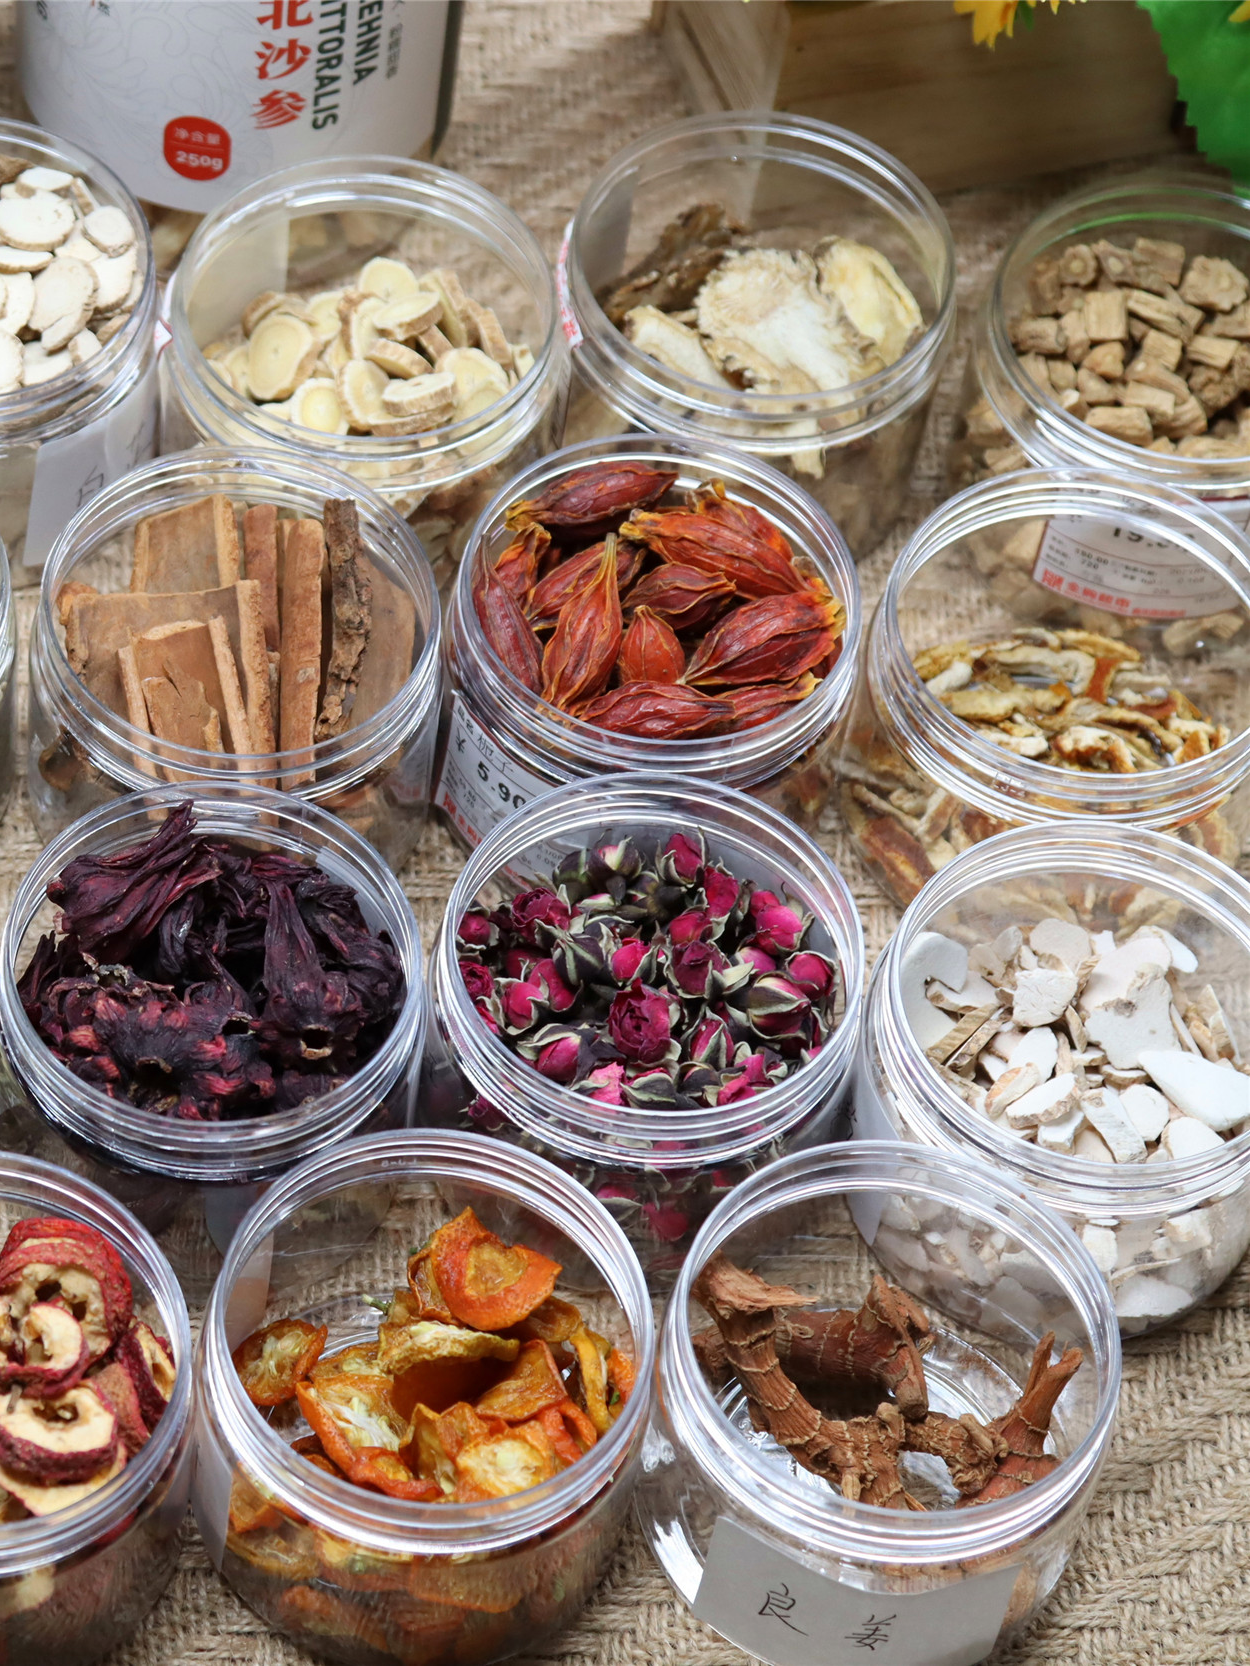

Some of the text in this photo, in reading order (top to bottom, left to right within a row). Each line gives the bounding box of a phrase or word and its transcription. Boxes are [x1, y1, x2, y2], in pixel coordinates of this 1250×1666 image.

[250, 0, 314, 130] 北沙参
[352, 0, 385, 86] EHNIA
[174, 125, 222, 146] 净含量
[175, 150, 224, 171] 250g
[477, 760, 527, 810] 5.90
[757, 1582, 898, 1652] 良姜
